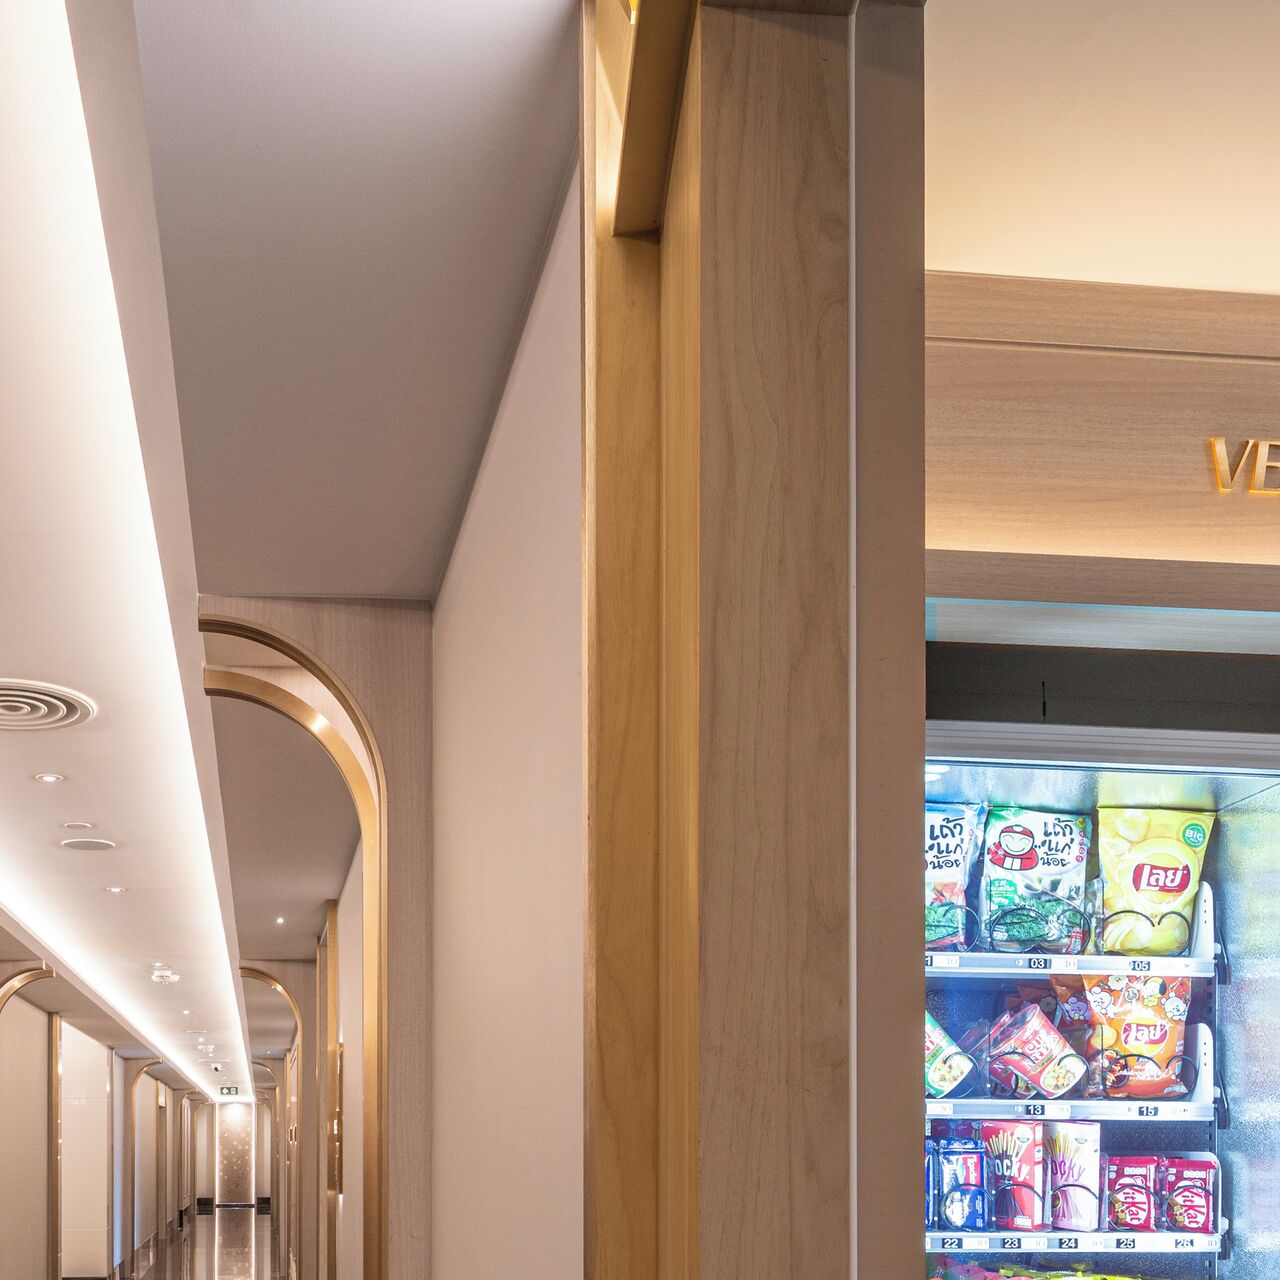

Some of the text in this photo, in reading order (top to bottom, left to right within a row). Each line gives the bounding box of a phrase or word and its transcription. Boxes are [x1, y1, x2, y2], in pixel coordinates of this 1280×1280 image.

[1185, 829, 1204, 843] BIG
[1030, 958, 1046, 969] 03
[1135, 962, 1149, 971] 05
[1027, 1105, 1042, 1115] 13
[1140, 1107, 1155, 1116] 15
[943, 1238, 959, 1248] 22
[1004, 1238, 1019, 1248] 23
[1061, 1238, 1077, 1248] 24
[1120, 1238, 1134, 1248] 25
[1176, 1238, 1191, 1248] 26
